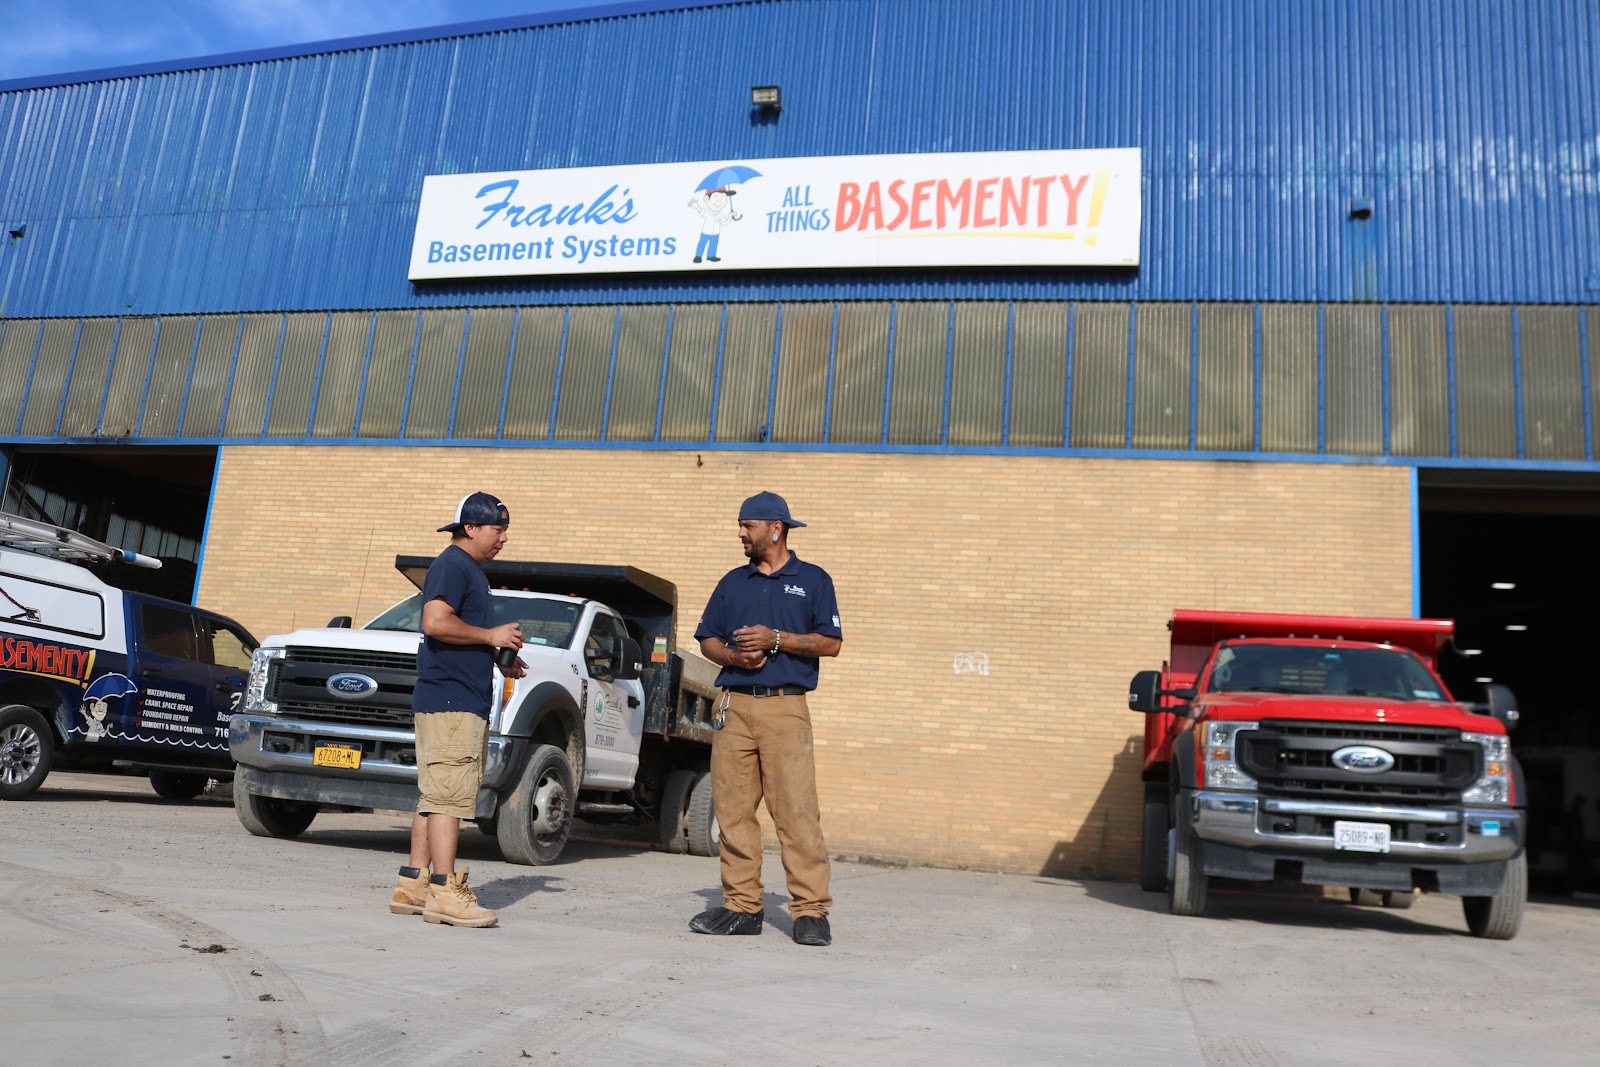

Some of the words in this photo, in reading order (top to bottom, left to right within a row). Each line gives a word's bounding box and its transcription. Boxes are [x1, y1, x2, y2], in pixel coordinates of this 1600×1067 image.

[782, 185, 814, 208] ALL
[475, 179, 639, 230] Frank's
[835, 167, 1112, 247] BASEMENTY!
[766, 208, 831, 234] THINGS
[427, 234, 554, 264] Basement
[561, 234, 677, 264] Systems
[338, 678, 363, 692] Ford
[146, 688, 186, 701] WATERPROOFING
[144, 699, 161, 708] CRAWL
[162, 701, 177, 710] SPACE
[177, 703, 194, 713] REPAIR
[142, 709, 173, 720] FOUNDATION
[172, 713, 190, 723] REPAIR
[141, 720, 165, 730] HUMIDITY
[165, 723, 170, 731] &
[170, 724, 183, 732] MOLD
[183, 725, 204, 735] CONTROL
[214, 726, 229, 738] 716
[1349, 752, 1379, 767] Ford
